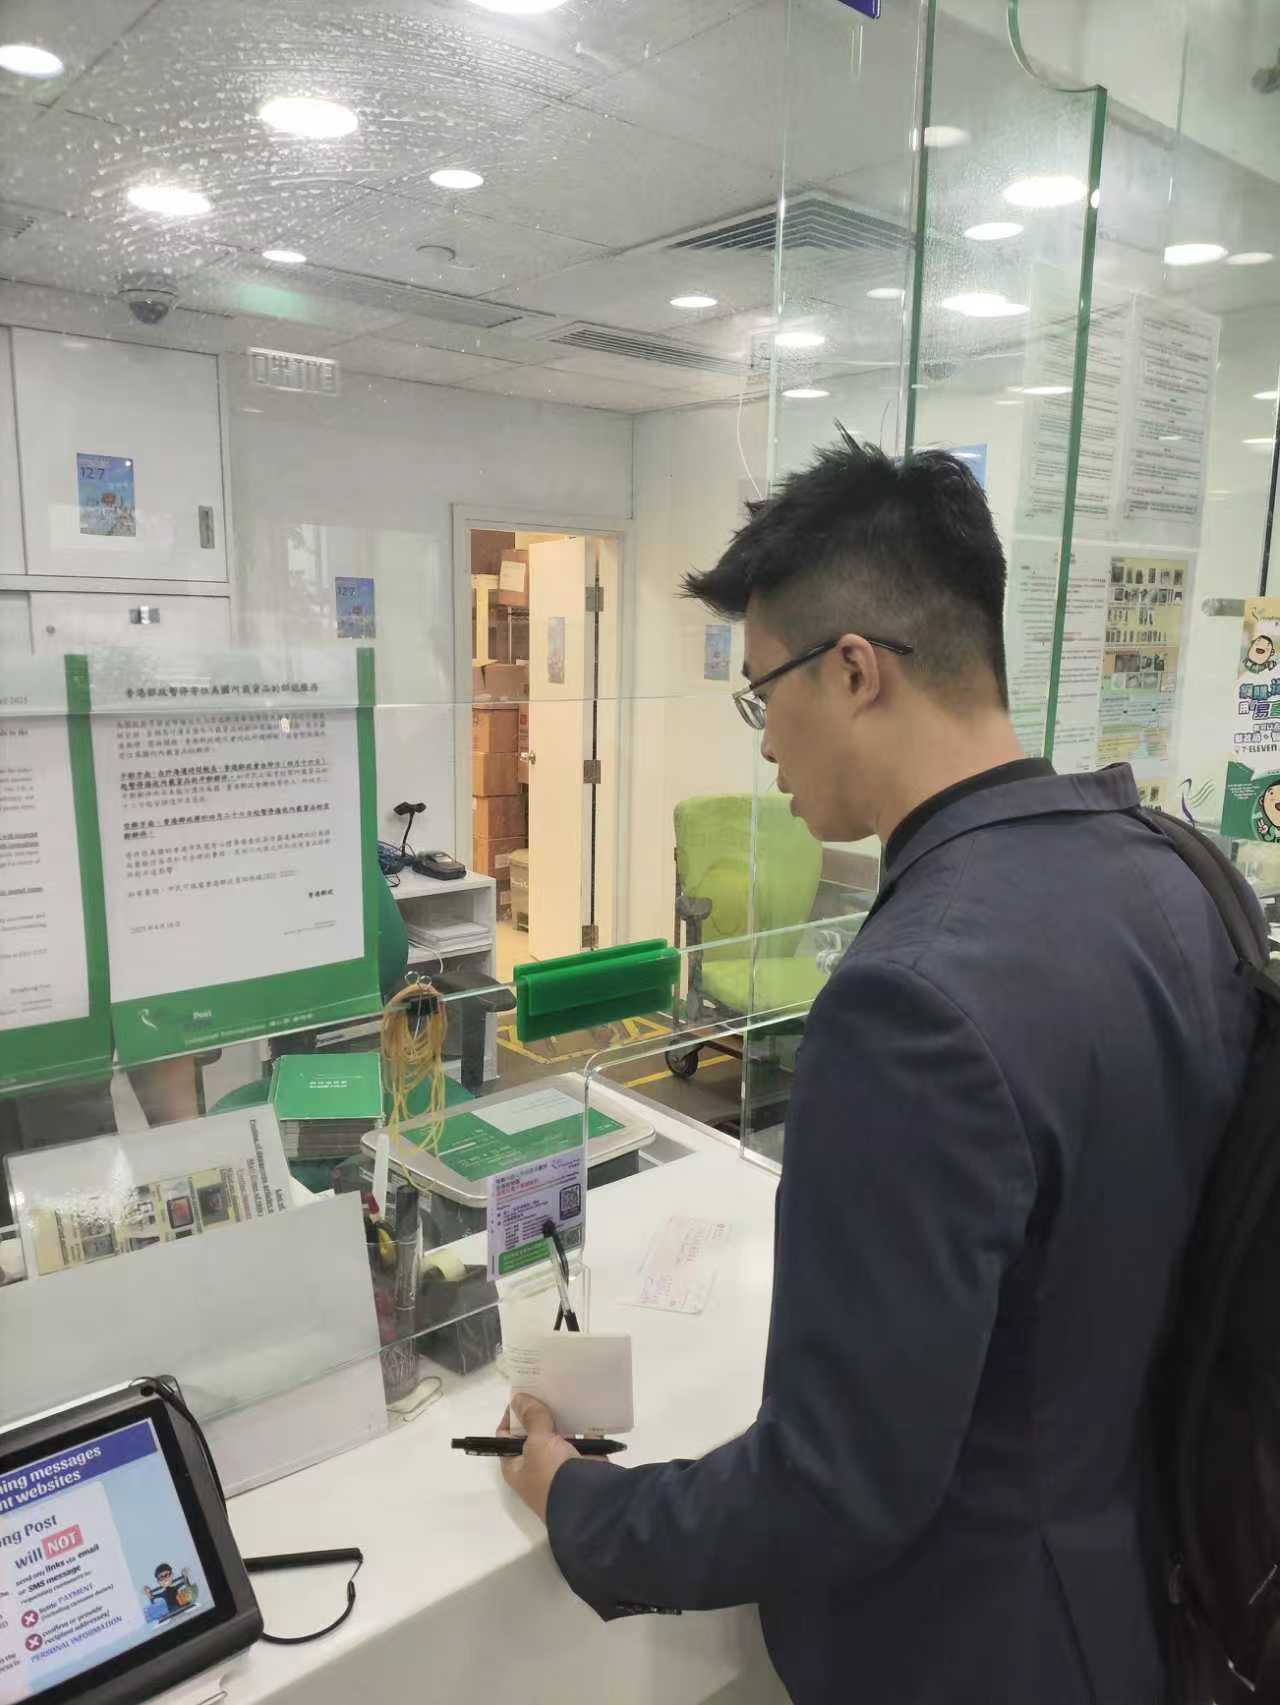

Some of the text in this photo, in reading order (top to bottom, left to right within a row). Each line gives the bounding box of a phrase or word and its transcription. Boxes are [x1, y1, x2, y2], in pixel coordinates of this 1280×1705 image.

[30, 1446, 102, 1482] messages
[15, 1469, 82, 1503] websites
[24, 1514, 58, 1537] Post
[15, 1531, 79, 1569] will NOT
[45, 1559, 66, 1574] links
[78, 1543, 100, 1558] email
[27, 1580, 46, 1593] SMS
[46, 1564, 82, 1584] message
[58, 1582, 94, 1604] PAYMENT
[70, 1615, 123, 1645] INFORMATION
